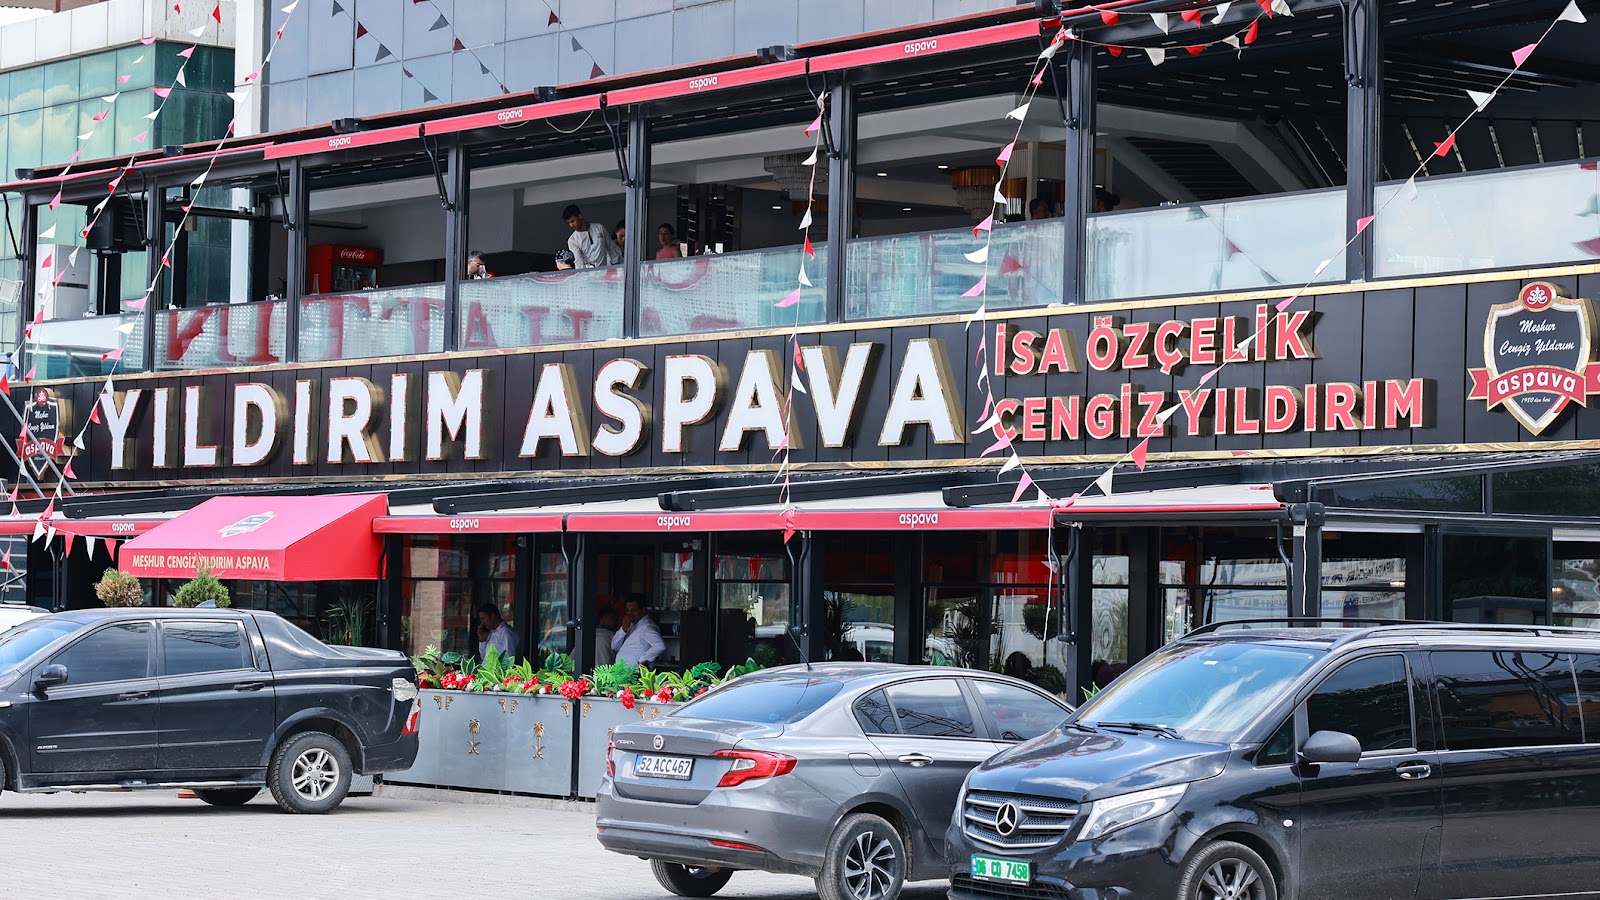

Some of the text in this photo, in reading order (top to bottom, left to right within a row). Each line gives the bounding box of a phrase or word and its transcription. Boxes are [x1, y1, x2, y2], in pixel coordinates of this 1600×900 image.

[904, 39, 937, 55] aspava
[689, 76, 718, 91] aspava
[497, 109, 523, 122] aspava
[328, 136, 351, 148] aspava
[1519, 319, 1557, 334] Meşhur
[994, 304, 1313, 376] İSA ÖZÇELİK
[1500, 338, 1576, 357] Cengiz Yıldırım
[1497, 371, 1577, 396] aspava
[99, 337, 964, 470] YILDIRIM ASPAVA
[993, 378, 1427, 442] CENGİZ YILDIRIM
[112, 523, 135, 534] aspava
[450, 518, 479, 531] aspava
[657, 515, 690, 530] aspava
[899, 513, 938, 529] aspava
[132, 554, 165, 570] MEŞHUR
[167, 552, 197, 569] CENGİZ
[235, 556, 270, 569] ASPAVA
[640, 757, 652, 771] 52
[991, 861, 1002, 877] CD
[1006, 862, 1028, 879] 7458
